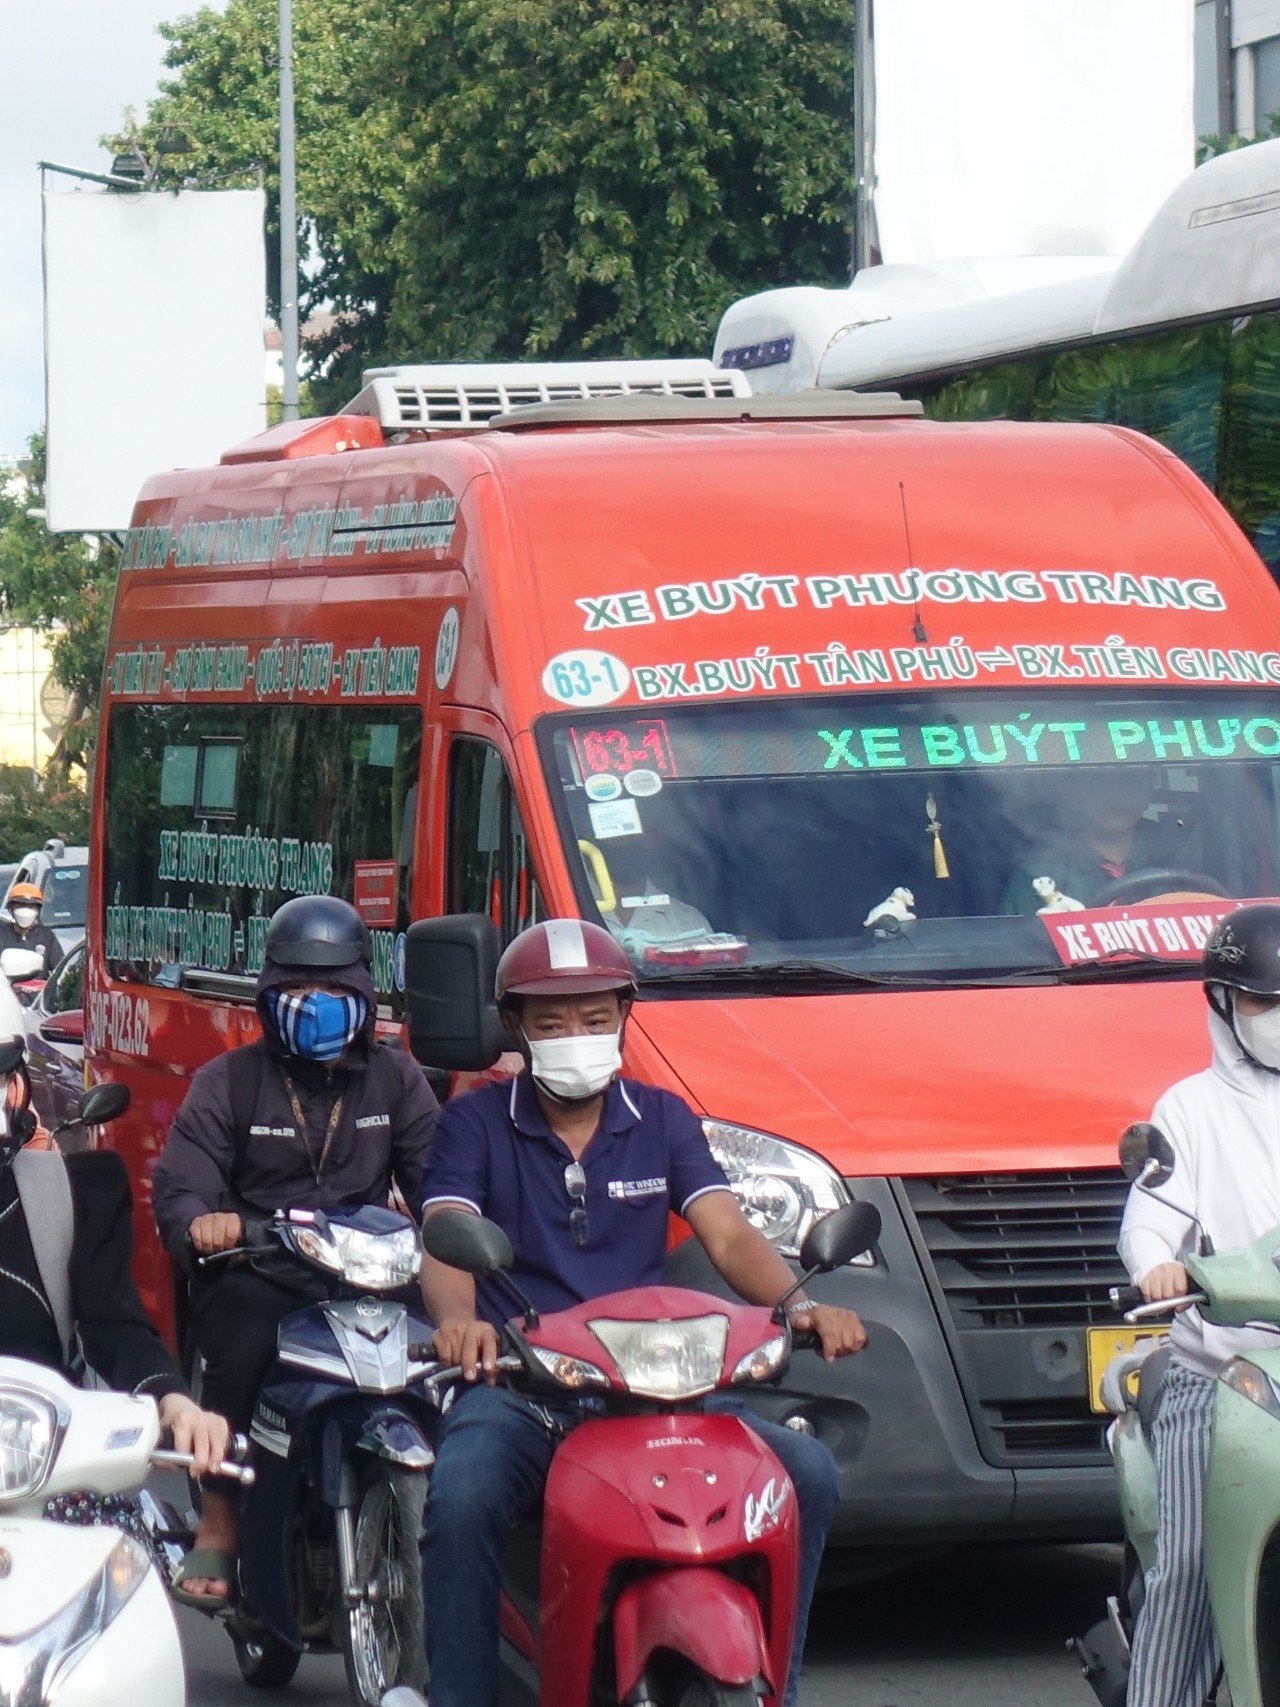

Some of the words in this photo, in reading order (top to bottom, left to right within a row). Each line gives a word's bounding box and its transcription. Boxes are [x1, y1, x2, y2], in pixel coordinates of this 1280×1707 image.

[579, 591, 654, 630] XE
[659, 575, 797, 619] BUÝT
[808, 570, 1044, 605] PHƯƠNG
[1045, 571, 1226, 611] TRANG
[551, 657, 620, 699] 63-1
[801, 643, 893, 684] TÂN
[891, 637, 976, 681] PHÚ
[583, 728, 668, 772] 63-1
[818, 728, 906, 768] XE
[921, 712, 1086, 765] BUÝT
[158, 830, 179, 880] XE
[178, 820, 219, 884] BUÝT
[280, 837, 333, 896] TRANG
[1057, 923, 1099, 960] XE
